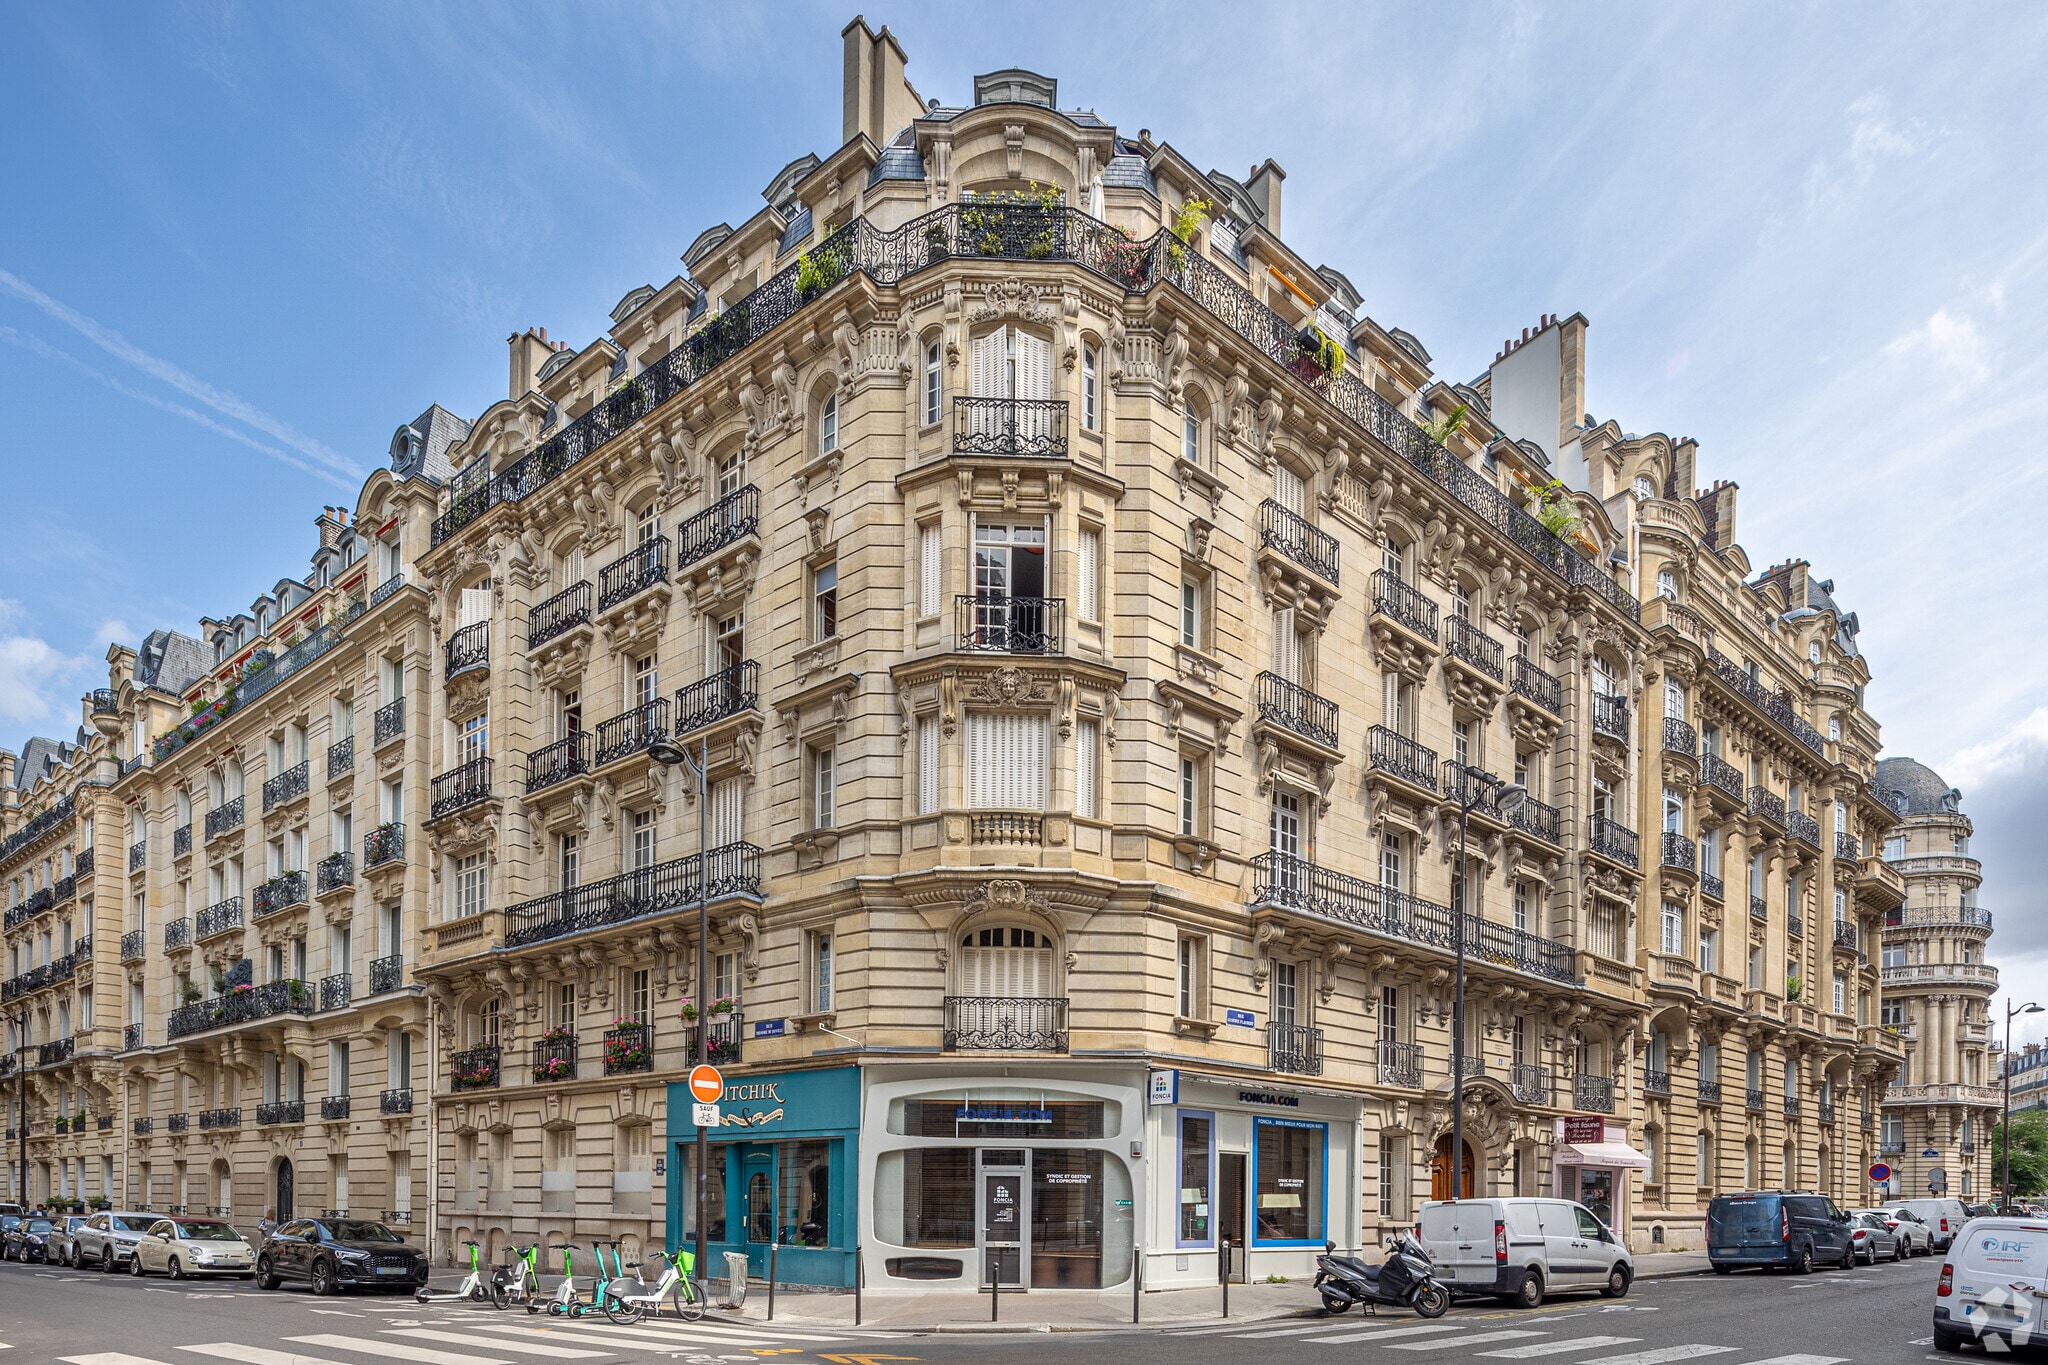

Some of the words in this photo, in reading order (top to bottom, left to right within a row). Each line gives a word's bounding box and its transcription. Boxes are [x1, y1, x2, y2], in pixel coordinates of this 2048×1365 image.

[720, 1082, 786, 1103] ITCHIK
[1239, 1091, 1299, 1107] FONCIA.COM
[956, 1107, 1053, 1121] FONCIA.COM
[2001, 1240, 2033, 1252] IRF
